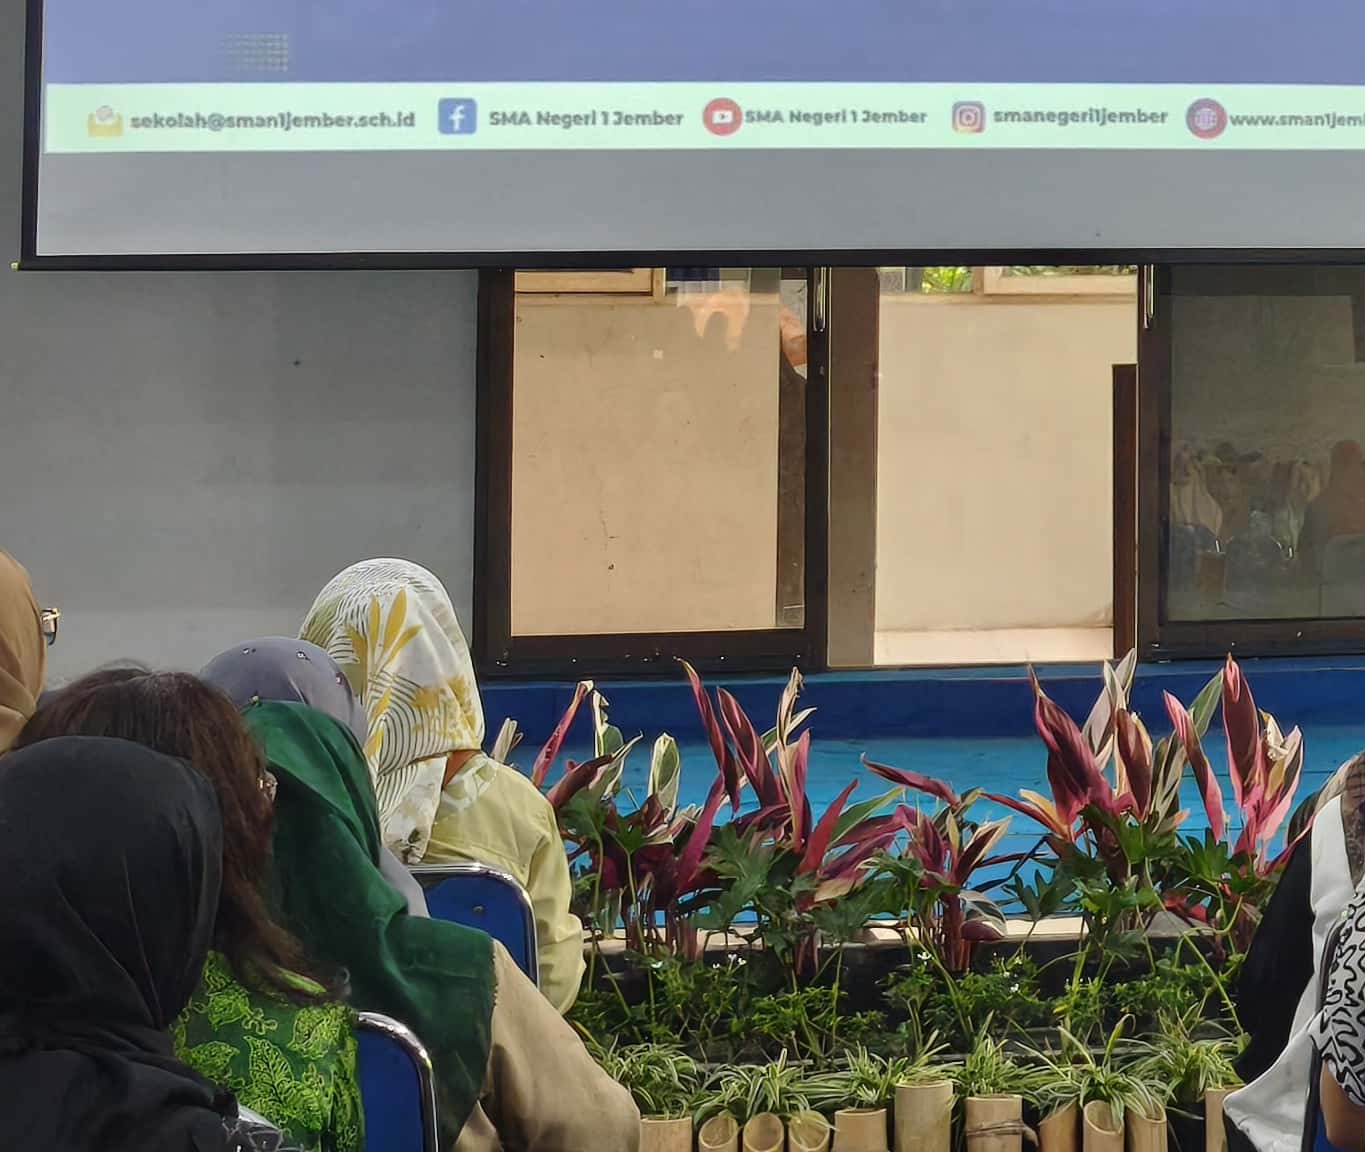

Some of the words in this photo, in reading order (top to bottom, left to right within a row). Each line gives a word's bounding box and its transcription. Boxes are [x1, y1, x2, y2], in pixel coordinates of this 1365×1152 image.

[130, 111, 415, 132] sekolah@sman1jember.sch.id
[489, 110, 531, 127] SMA
[536, 109, 597, 129] Negeri
[612, 110, 684, 127] Jember
[745, 110, 784, 125] SMA
[789, 109, 847, 126] Negeri
[862, 109, 928, 125] Jember
[993, 107, 1169, 127] smanegeri1jember
